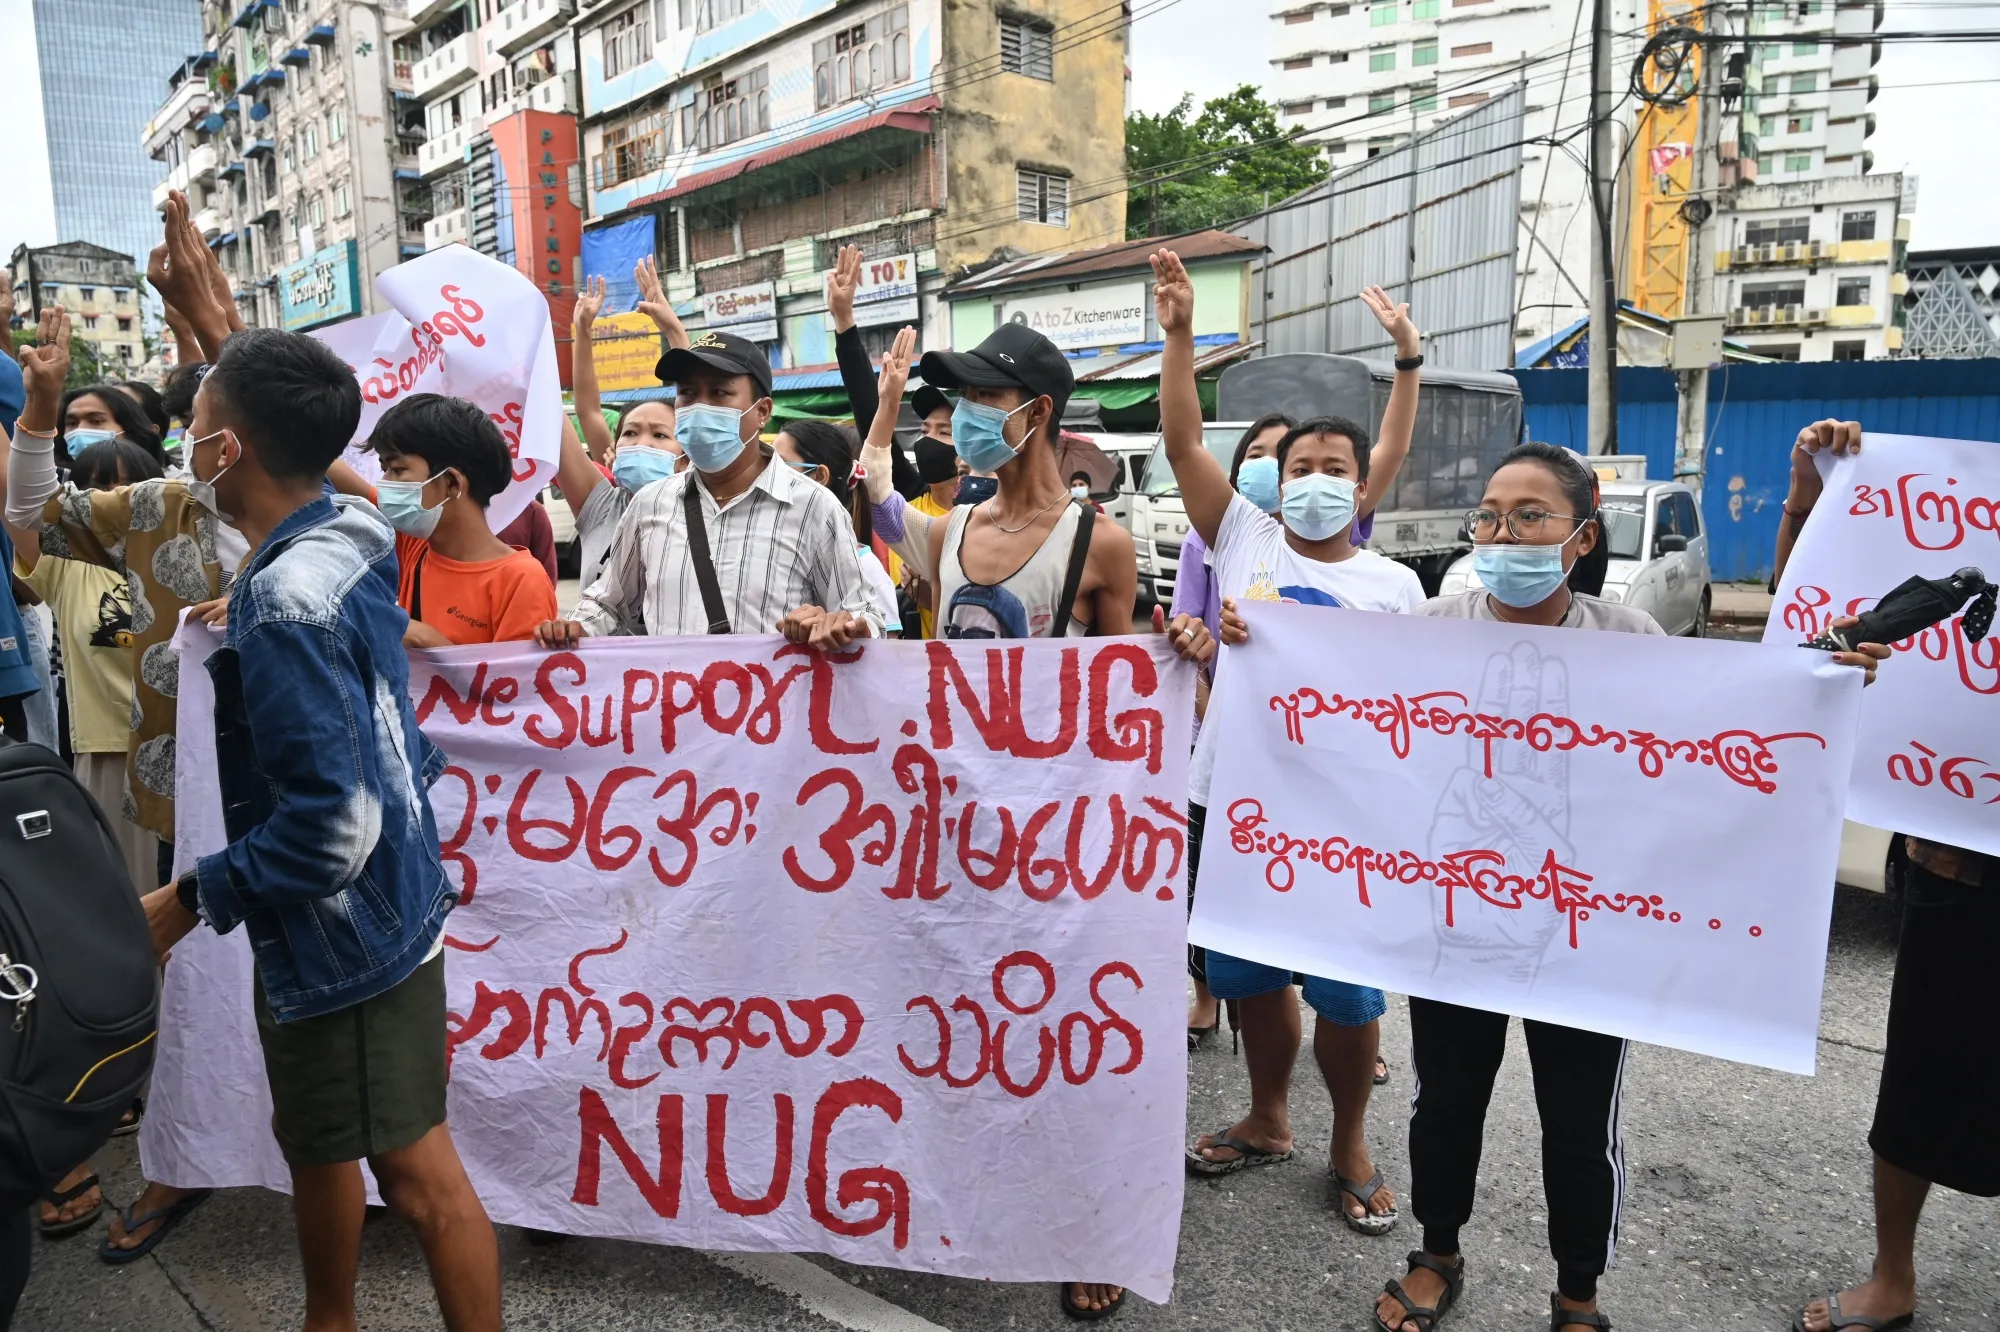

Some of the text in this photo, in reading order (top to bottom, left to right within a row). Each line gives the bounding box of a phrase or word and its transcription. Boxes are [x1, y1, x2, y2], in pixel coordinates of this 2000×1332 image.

[870, 259, 907, 284] TOY
[1031, 306, 1141, 329] A to Z Kitchenware
[455, 610, 488, 629] Georgian
[571, 1076, 910, 1250] NUG
